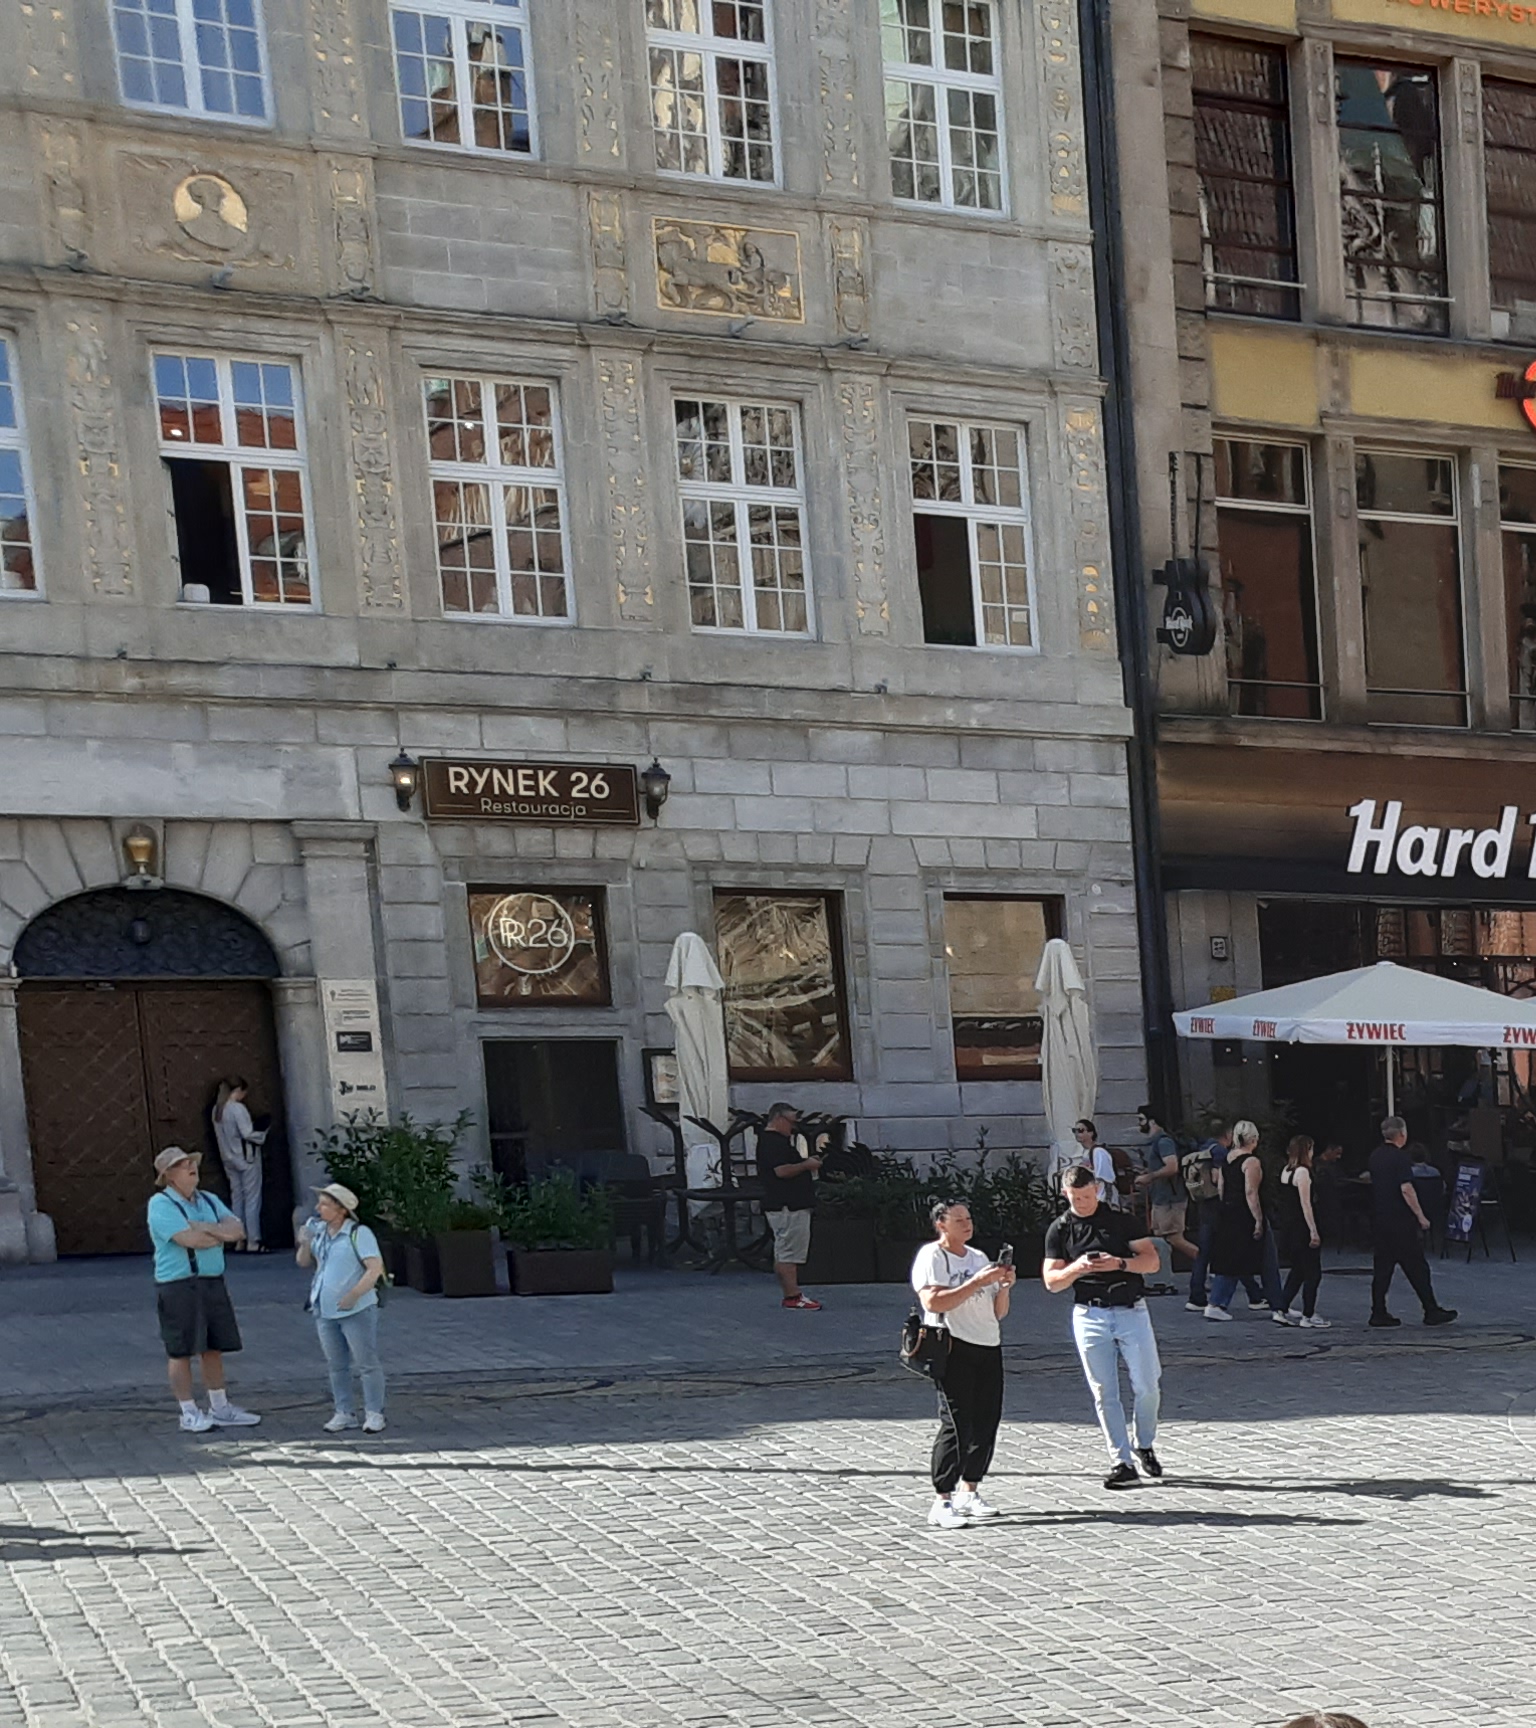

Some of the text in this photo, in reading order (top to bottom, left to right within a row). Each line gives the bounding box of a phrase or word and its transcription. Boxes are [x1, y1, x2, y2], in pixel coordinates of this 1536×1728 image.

[447, 766, 611, 799] RYNEK 26
[480, 797, 588, 820] Restauracja
[1346, 799, 1519, 878] Hard
[1346, 1022, 1407, 1041] ŻYWIEC
